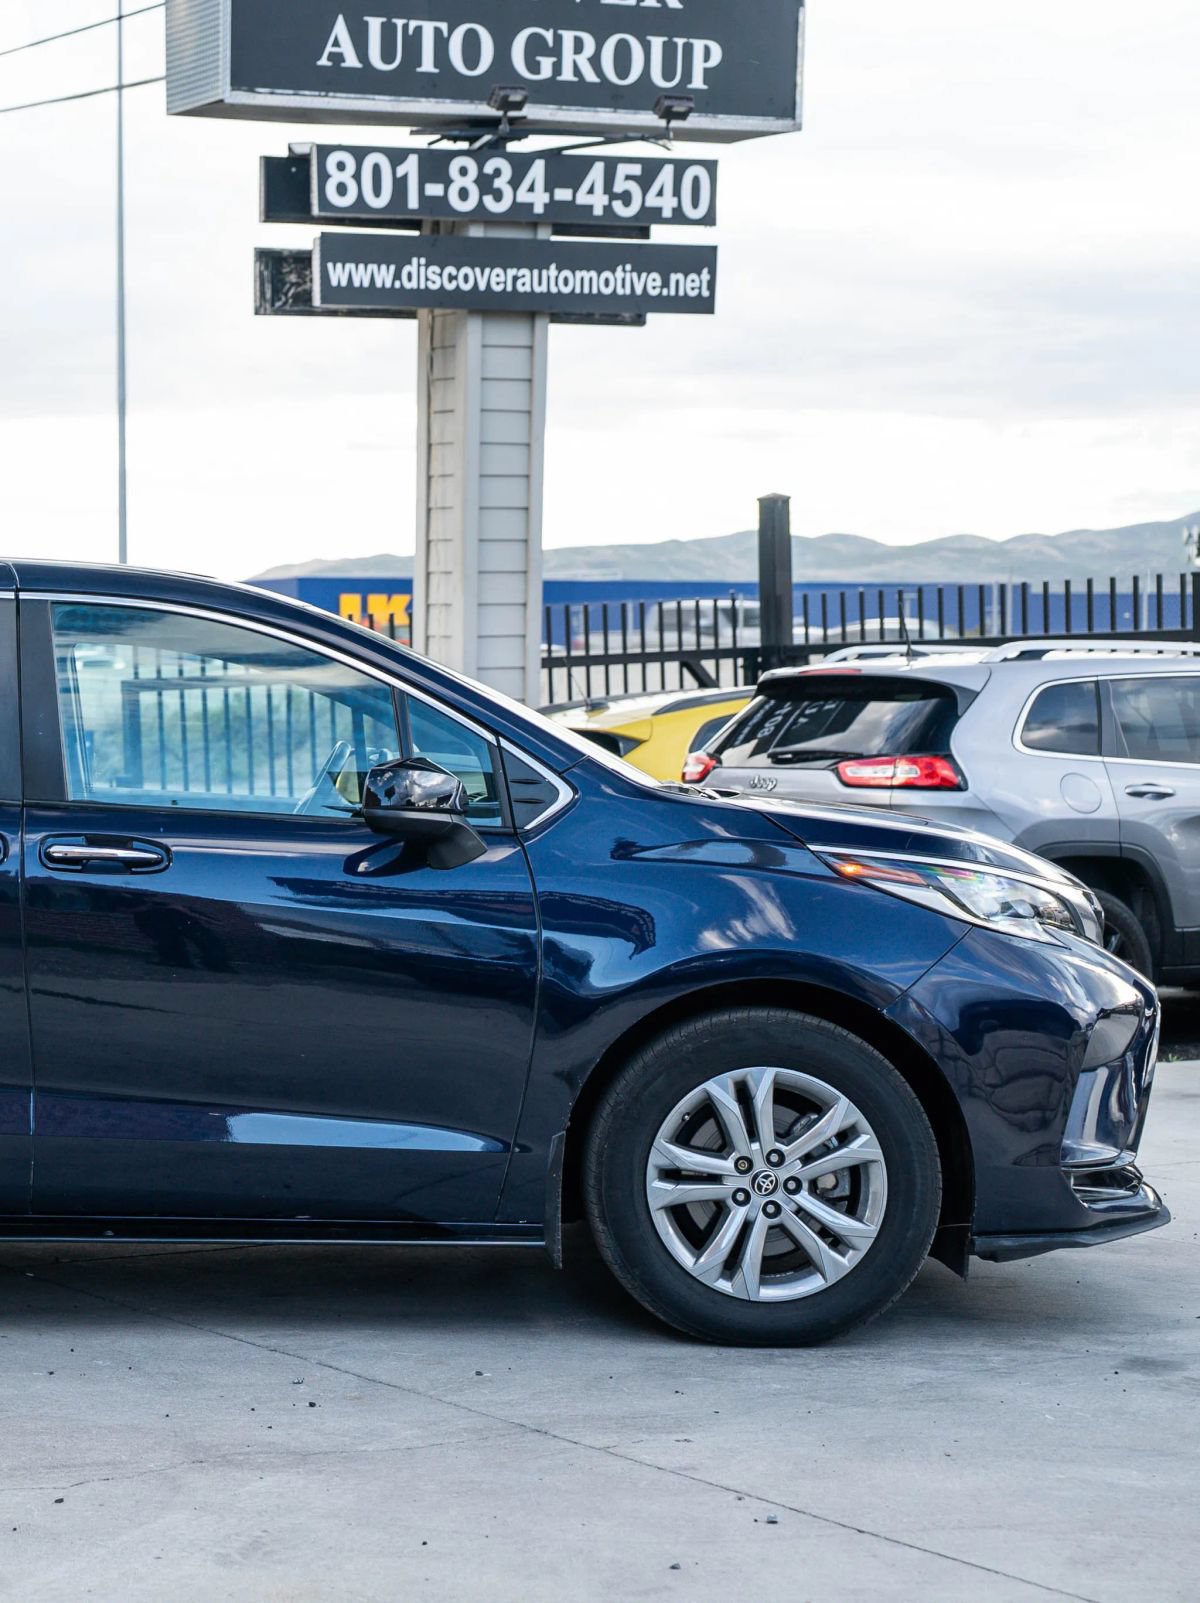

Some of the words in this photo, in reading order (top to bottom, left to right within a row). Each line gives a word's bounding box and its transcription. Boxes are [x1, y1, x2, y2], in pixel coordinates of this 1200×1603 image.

[316, 13, 496, 77] AUTO
[510, 26, 723, 90] GROUP
[324, 150, 712, 220] 801-834-4540
[326, 256, 711, 298] www.discoverautomotive.net
[339, 593, 412, 626] IK
